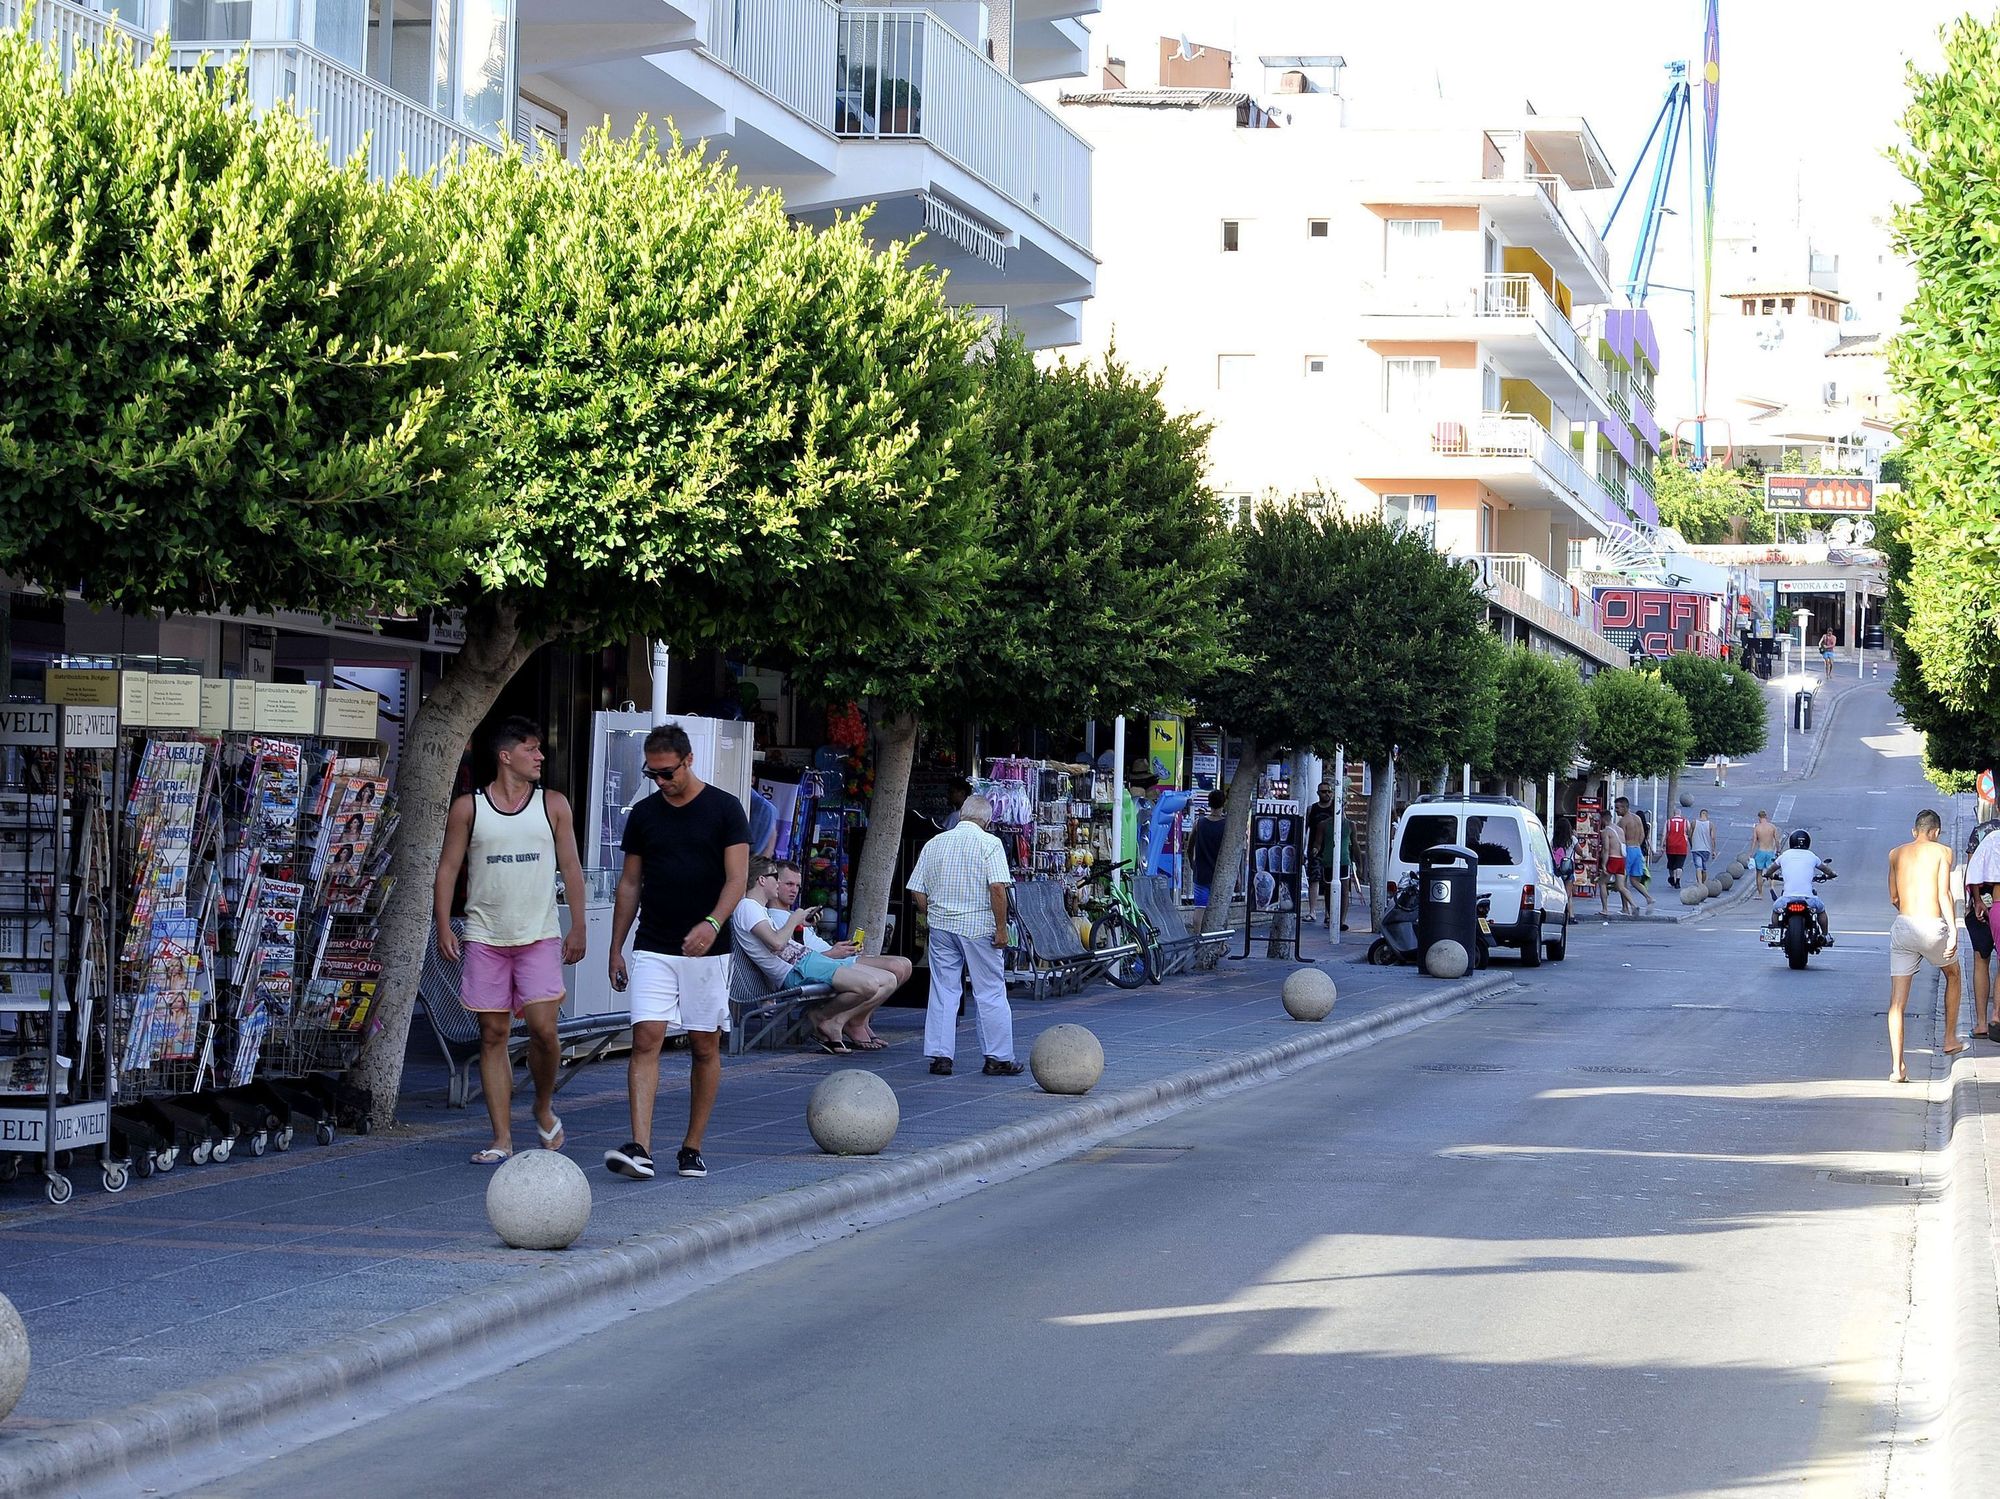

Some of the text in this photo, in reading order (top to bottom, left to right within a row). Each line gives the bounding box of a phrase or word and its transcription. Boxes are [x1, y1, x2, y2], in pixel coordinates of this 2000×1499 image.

[1808, 488, 1868, 507] GRILL
[1791, 582, 1821, 590] VODKA
[65, 714, 116, 735] DIE WELT
[251, 737, 299, 757] Coches
[1258, 803, 1298, 816] TATTOO
[486, 854, 513, 865] SUPER
[0, 1119, 43, 1142] ELT
[56, 1113, 106, 1141] DIE WELT
